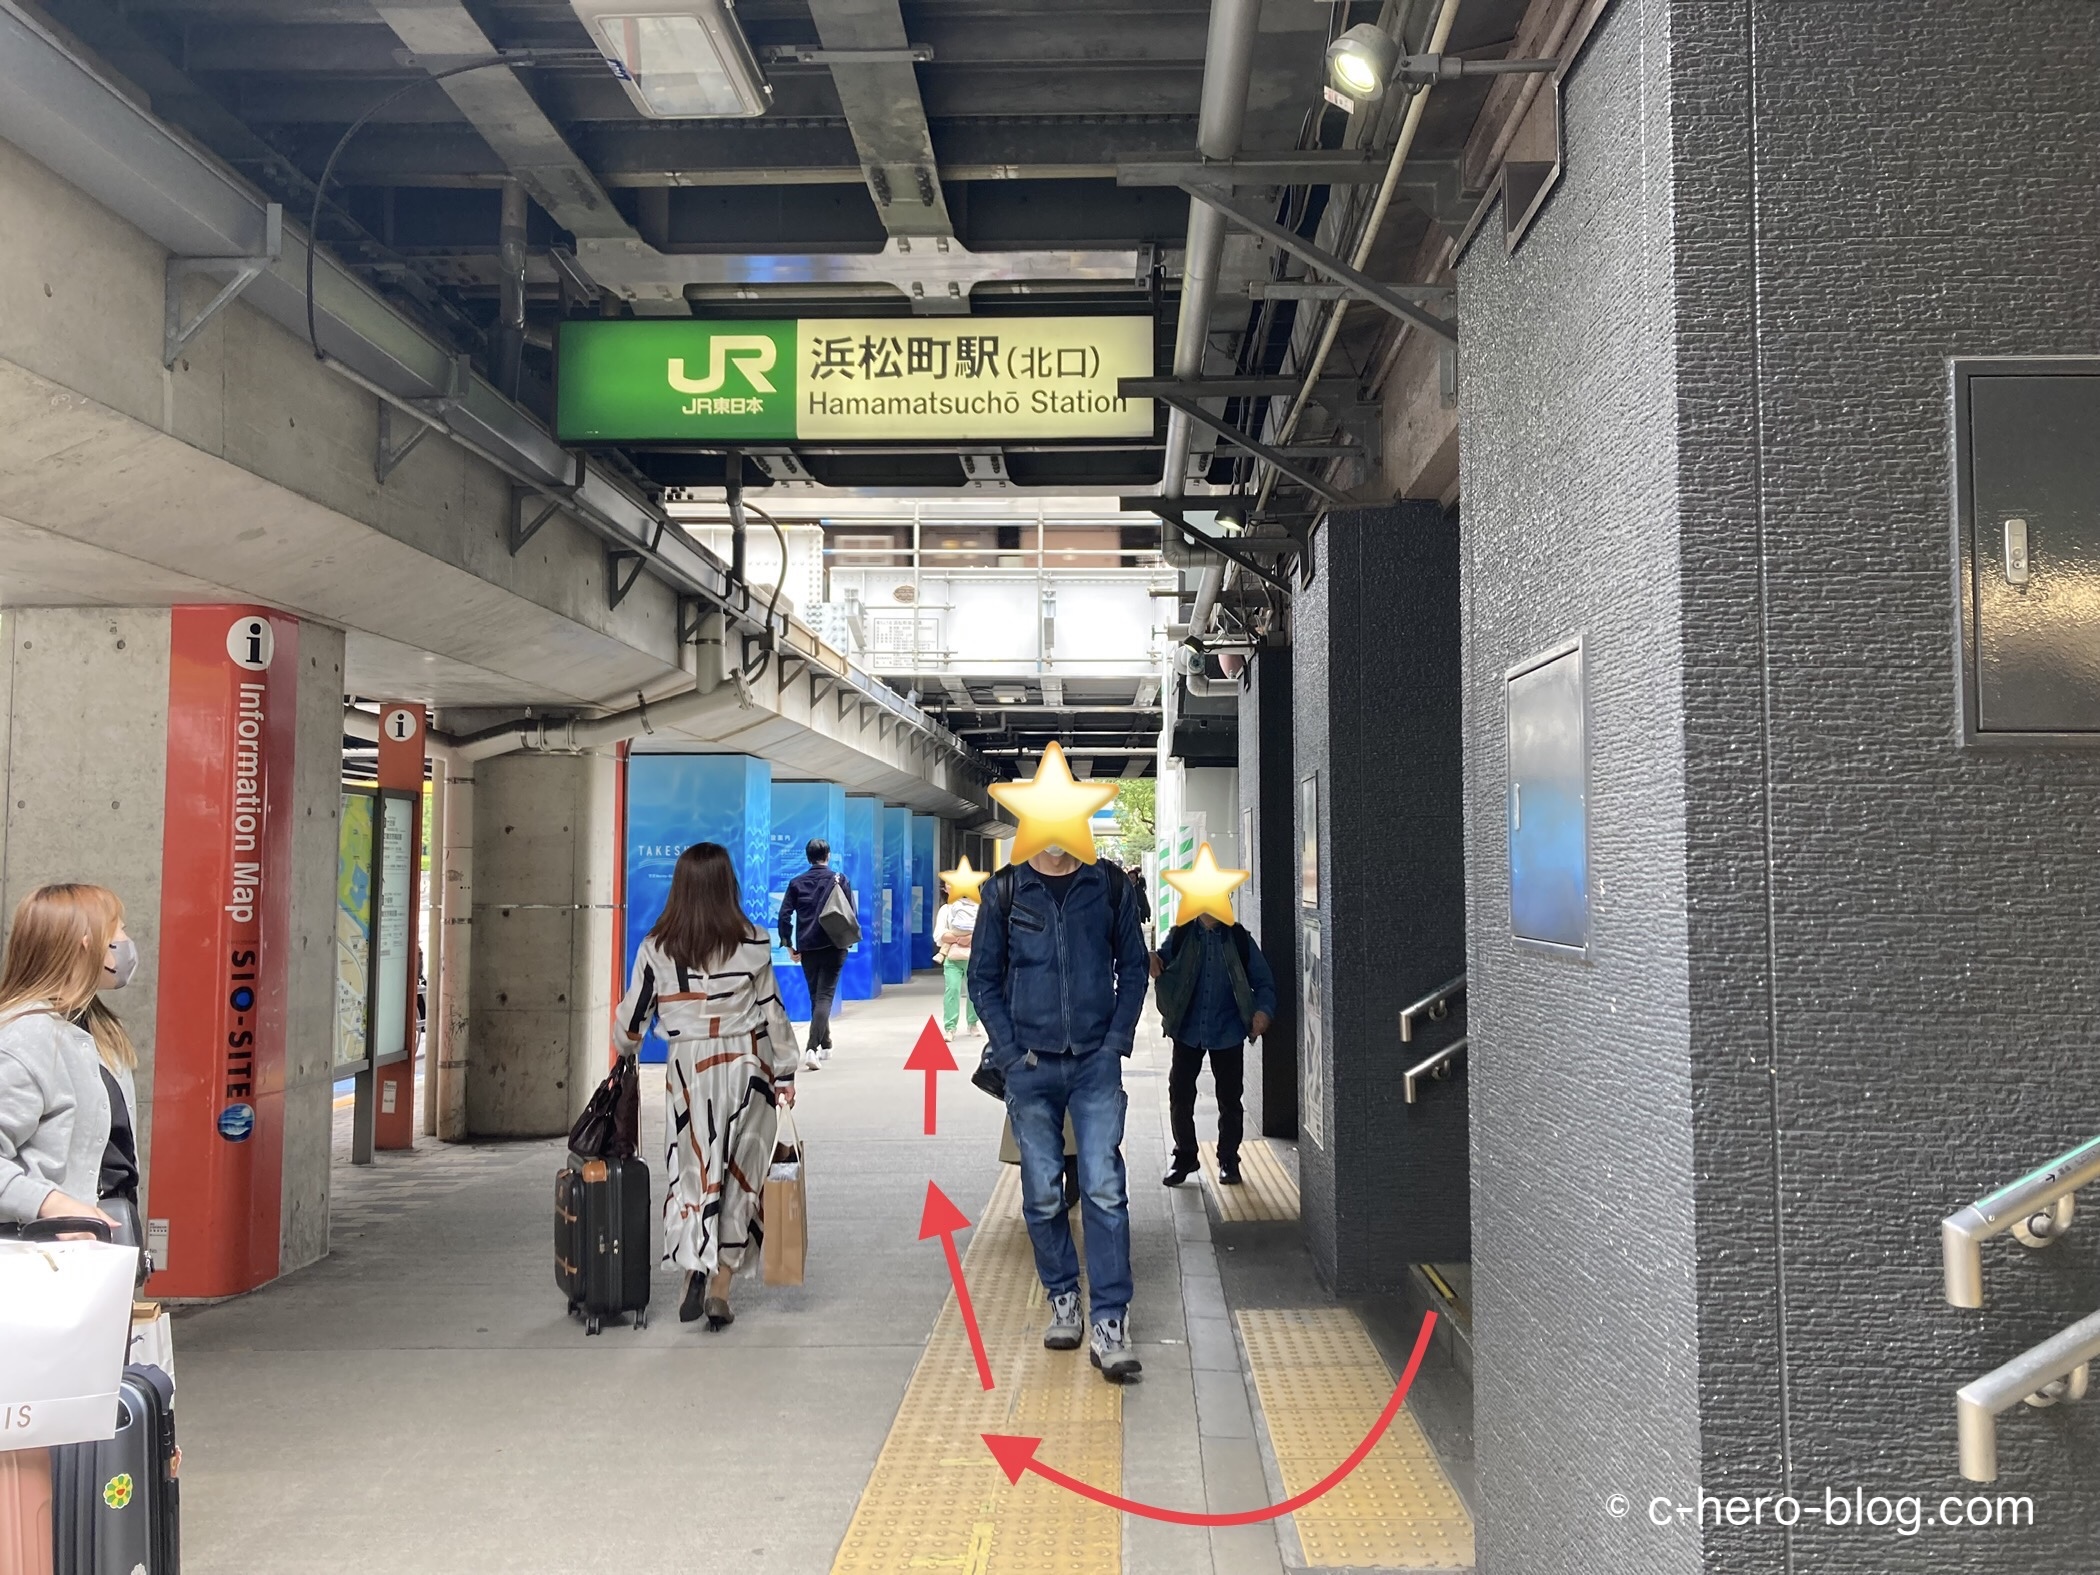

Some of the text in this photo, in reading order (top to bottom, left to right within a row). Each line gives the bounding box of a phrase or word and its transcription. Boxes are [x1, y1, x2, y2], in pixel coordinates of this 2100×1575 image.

[668, 335, 777, 393] JR
[682, 397, 763, 415] JR東日本
[809, 389, 1127, 414] Hamamatsuchō Station
[234, 683, 266, 851] Information
[225, 862, 260, 923] Map
[226, 949, 256, 1099] SIO-SITE
